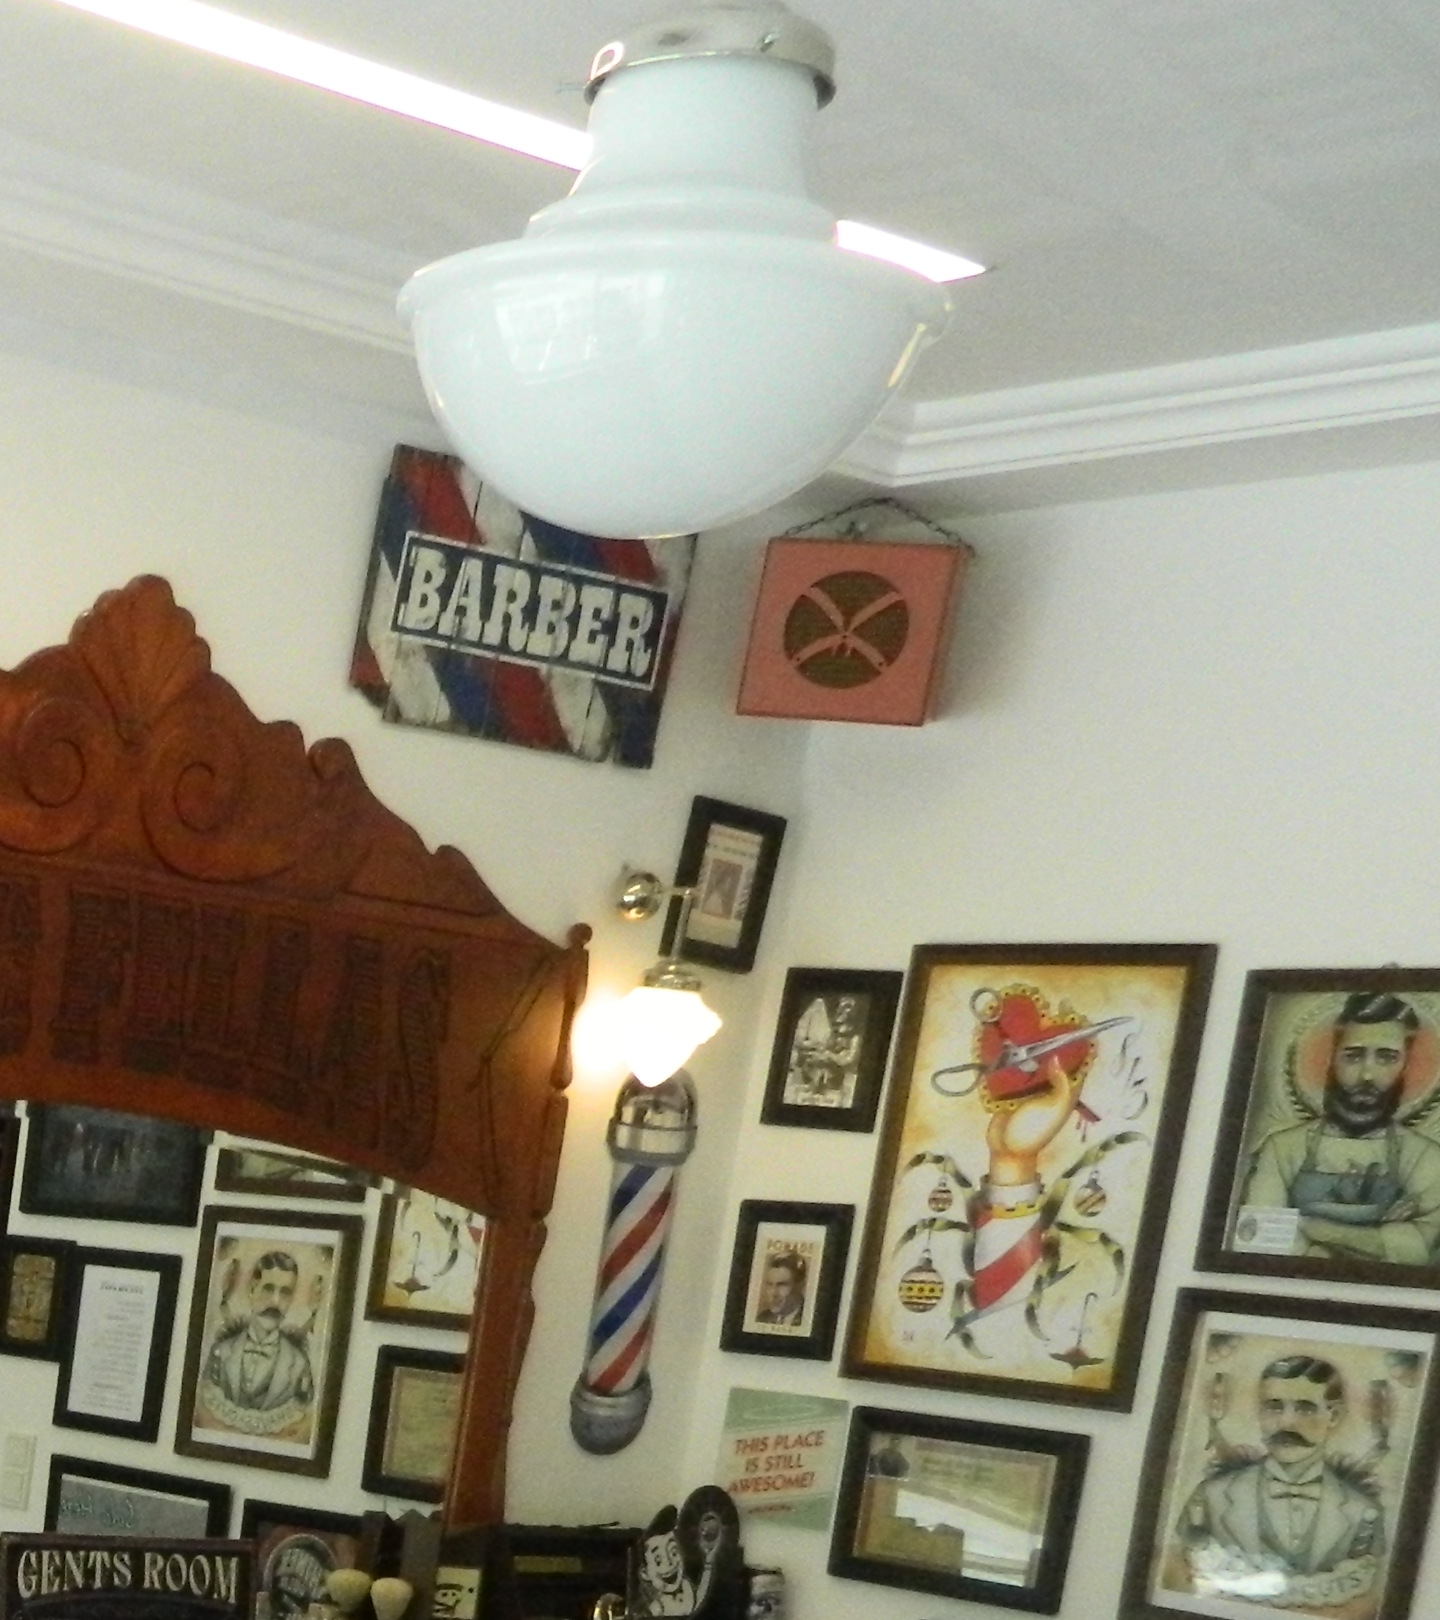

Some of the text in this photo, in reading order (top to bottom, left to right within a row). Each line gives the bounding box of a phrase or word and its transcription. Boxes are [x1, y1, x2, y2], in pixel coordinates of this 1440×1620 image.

[397, 546, 654, 678] BARBER
[734, 1429, 826, 1455] THIS PLACE
[744, 1453, 804, 1473] IS STILL
[728, 1470, 816, 1493] AWESOME!
[16, 1550, 133, 1600] GENTS
[142, 1551, 240, 1604] ROOM
